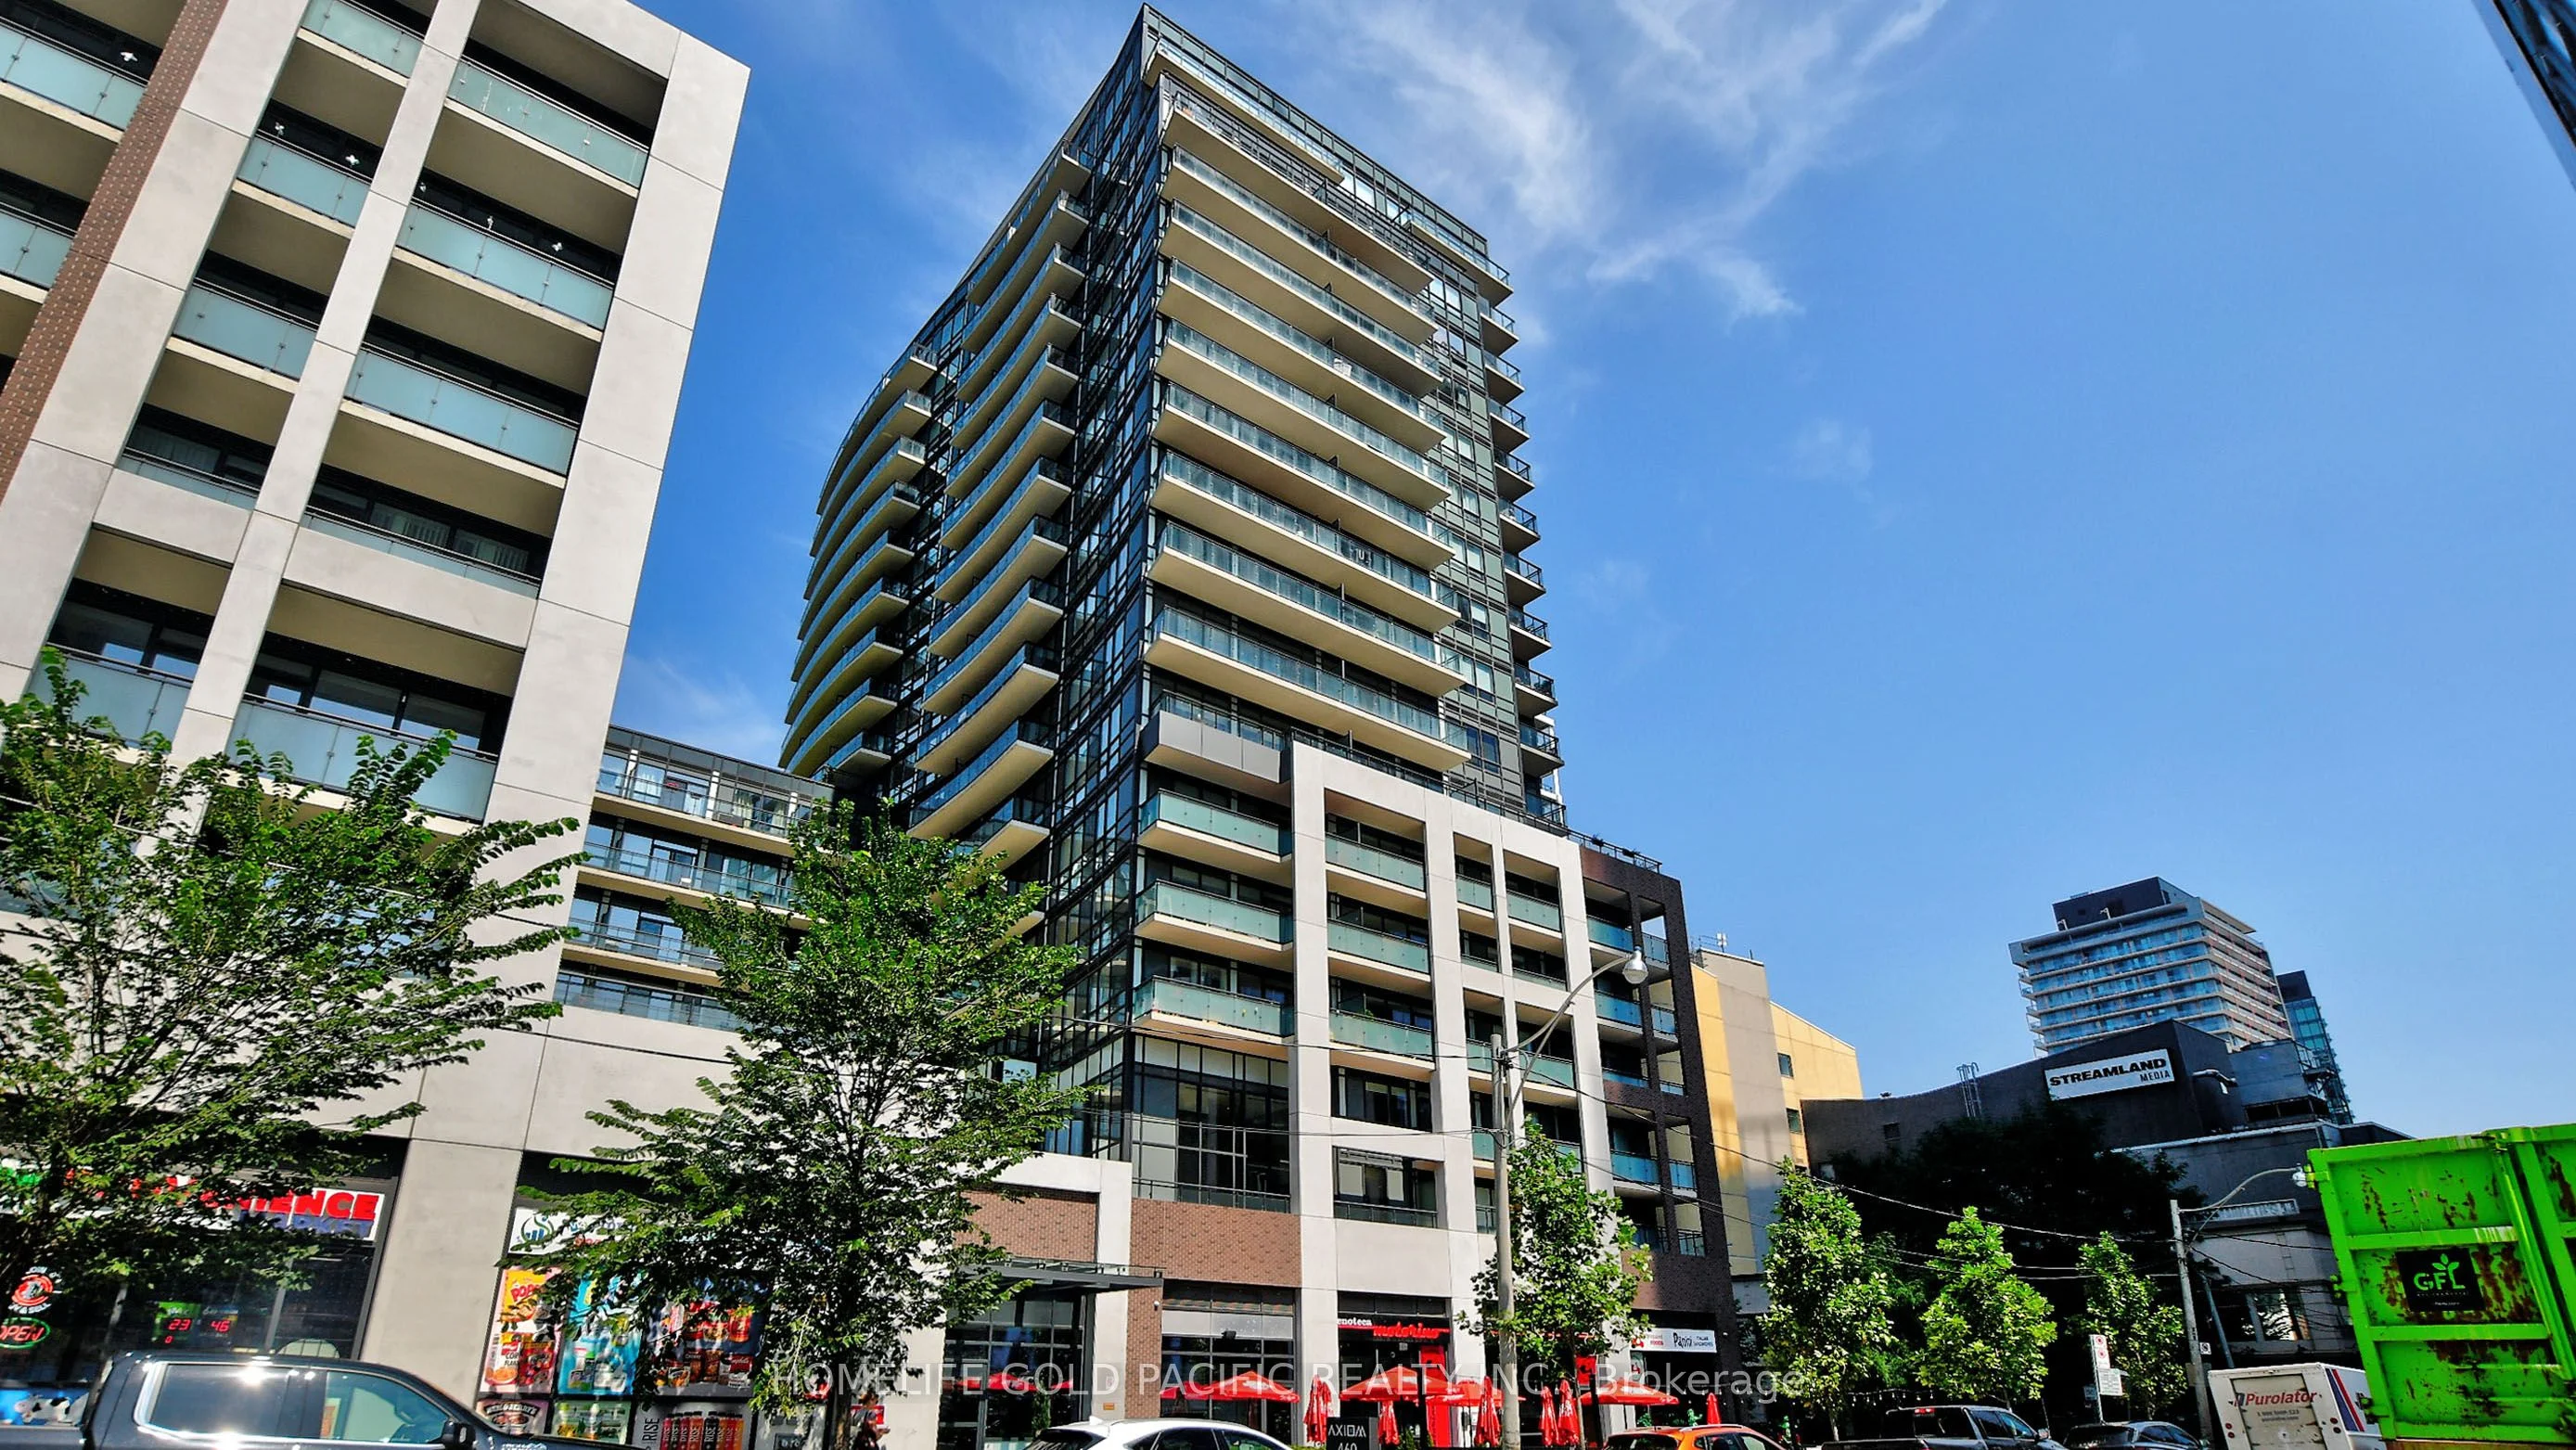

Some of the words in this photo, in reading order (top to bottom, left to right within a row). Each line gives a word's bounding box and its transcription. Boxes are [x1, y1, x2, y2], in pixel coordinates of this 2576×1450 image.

[2049, 1058, 2167, 1086] STREAMLAND
[2140, 1070, 2171, 1083] MEDIA
[2414, 1262, 2467, 1290] GFL
[168, 1318, 192, 1330] 23
[211, 1320, 230, 1332] 46
[1338, 1317, 1372, 1326] enoteca
[2246, 1392, 2317, 1407] Purolator
[642, 1418, 660, 1441] RISE
[704, 1426, 716, 1442] RISE
[1327, 1424, 1366, 1437] AXIOM
